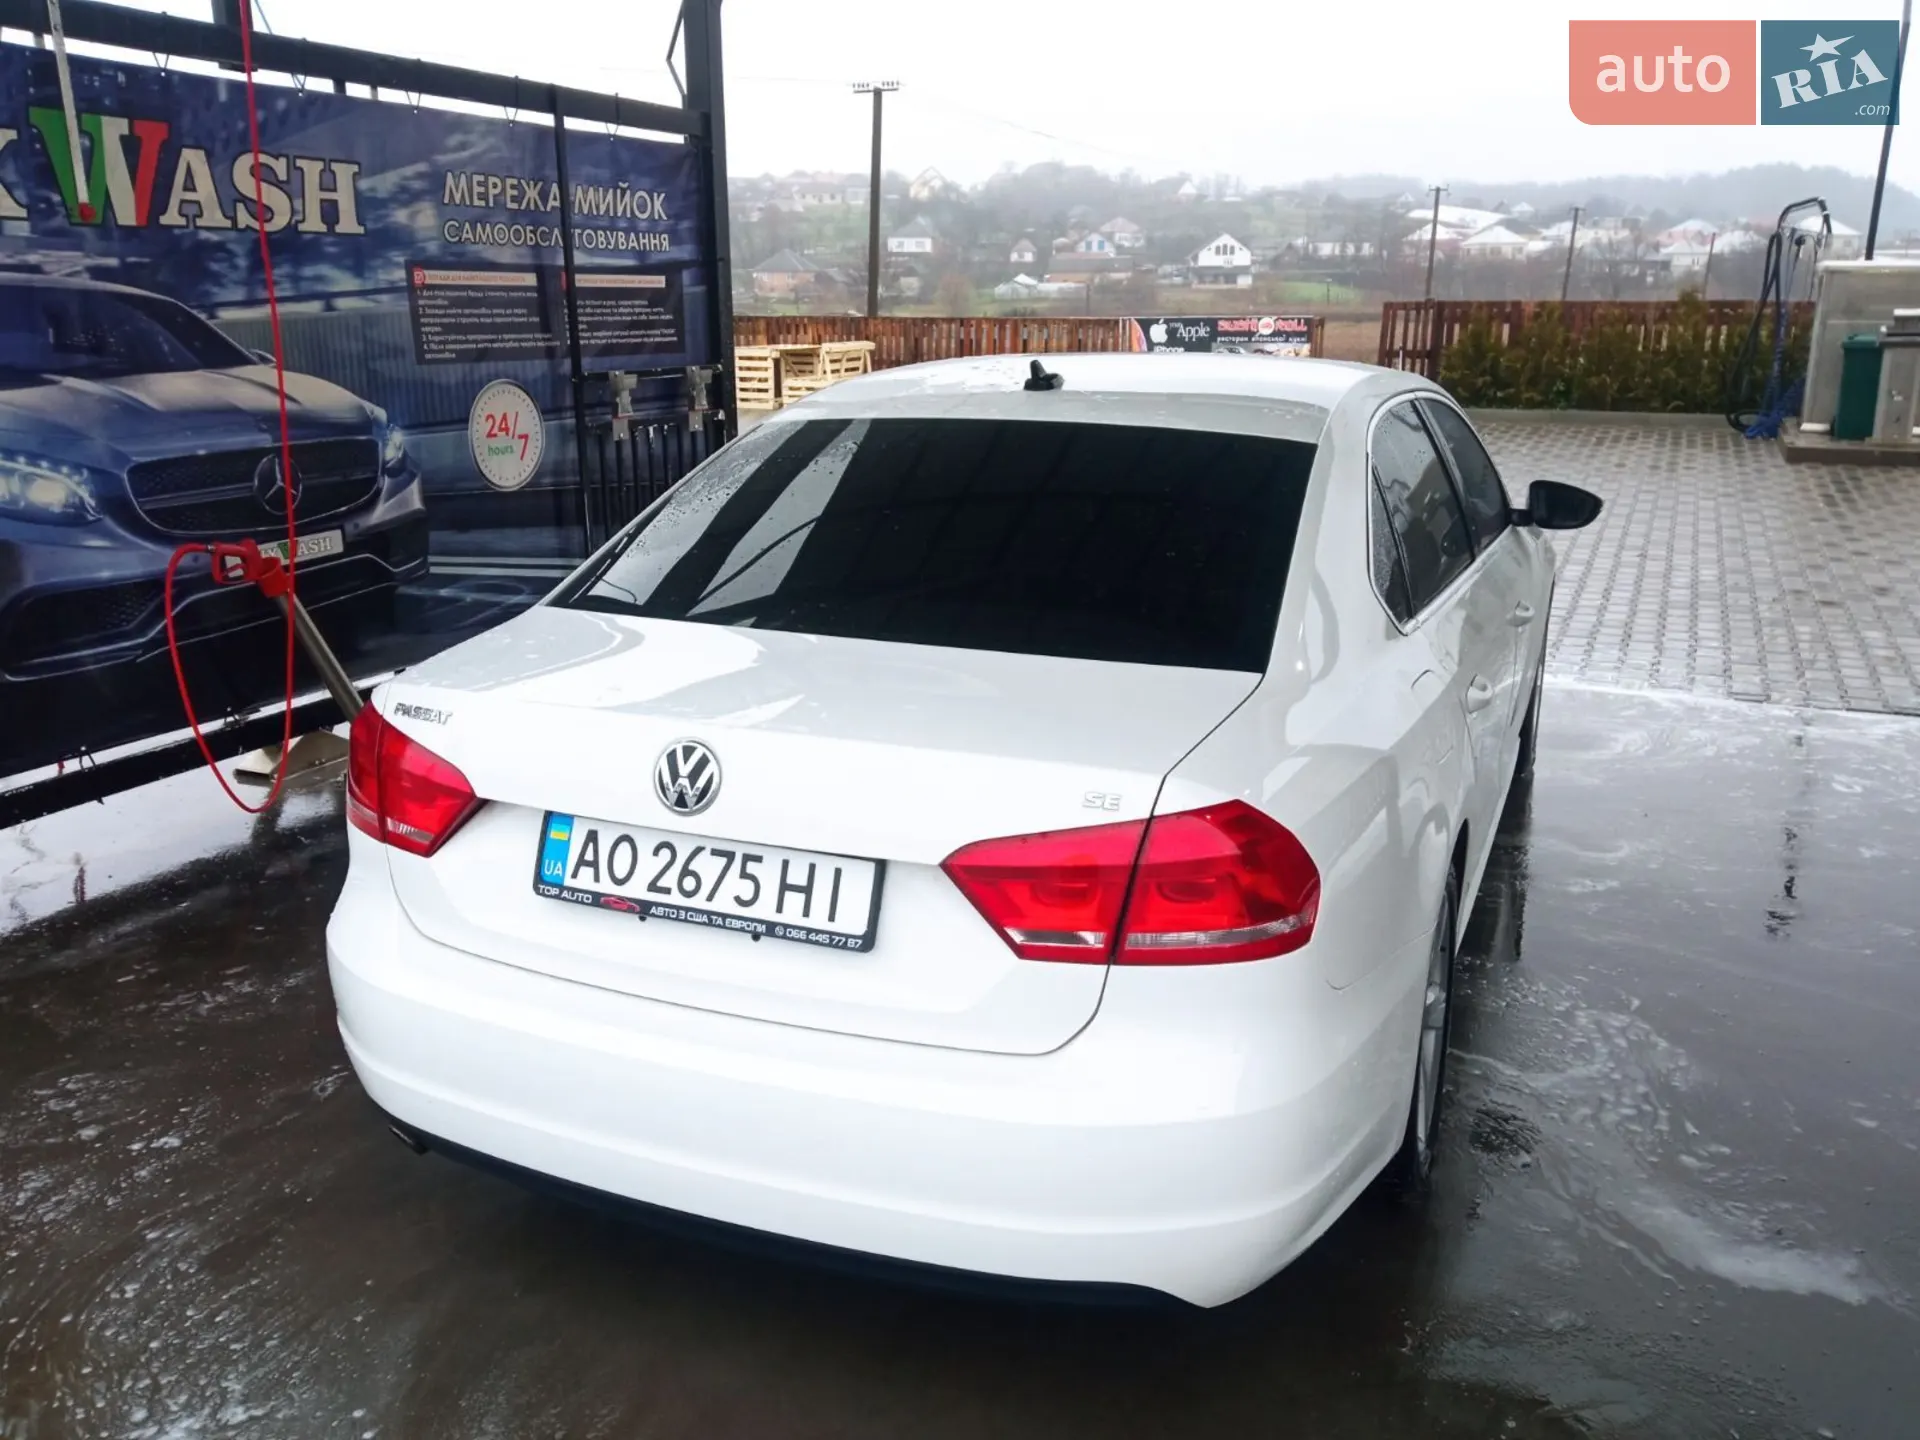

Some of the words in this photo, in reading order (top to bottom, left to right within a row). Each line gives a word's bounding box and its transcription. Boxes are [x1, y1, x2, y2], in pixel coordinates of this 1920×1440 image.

[443, 171, 560, 212] МЕРЕЖА
[573, 182, 668, 221] МИЙОК
[443, 219, 671, 252] САМООБСЛГОВУВАННЯ
[1176, 321, 1211, 342] Apple
[487, 444, 514, 457] hours
[394, 702, 454, 726] PASSAT
[1082, 791, 1121, 811] SE
[544, 861, 563, 877] UA
[571, 829, 638, 886] AO
[646, 841, 764, 908] 2675
[775, 859, 842, 923] HI
[538, 884, 560, 896] TOP
[561, 890, 593, 904] AUTO
[649, 905, 677, 918] АВТО
[686, 911, 709, 924] США
[710, 915, 724, 926] ТА
[725, 918, 767, 934] ЕВРОПИ
[786, 928, 808, 940] 066
[808, 932, 830, 944] 445
[831, 935, 846, 947] 77
